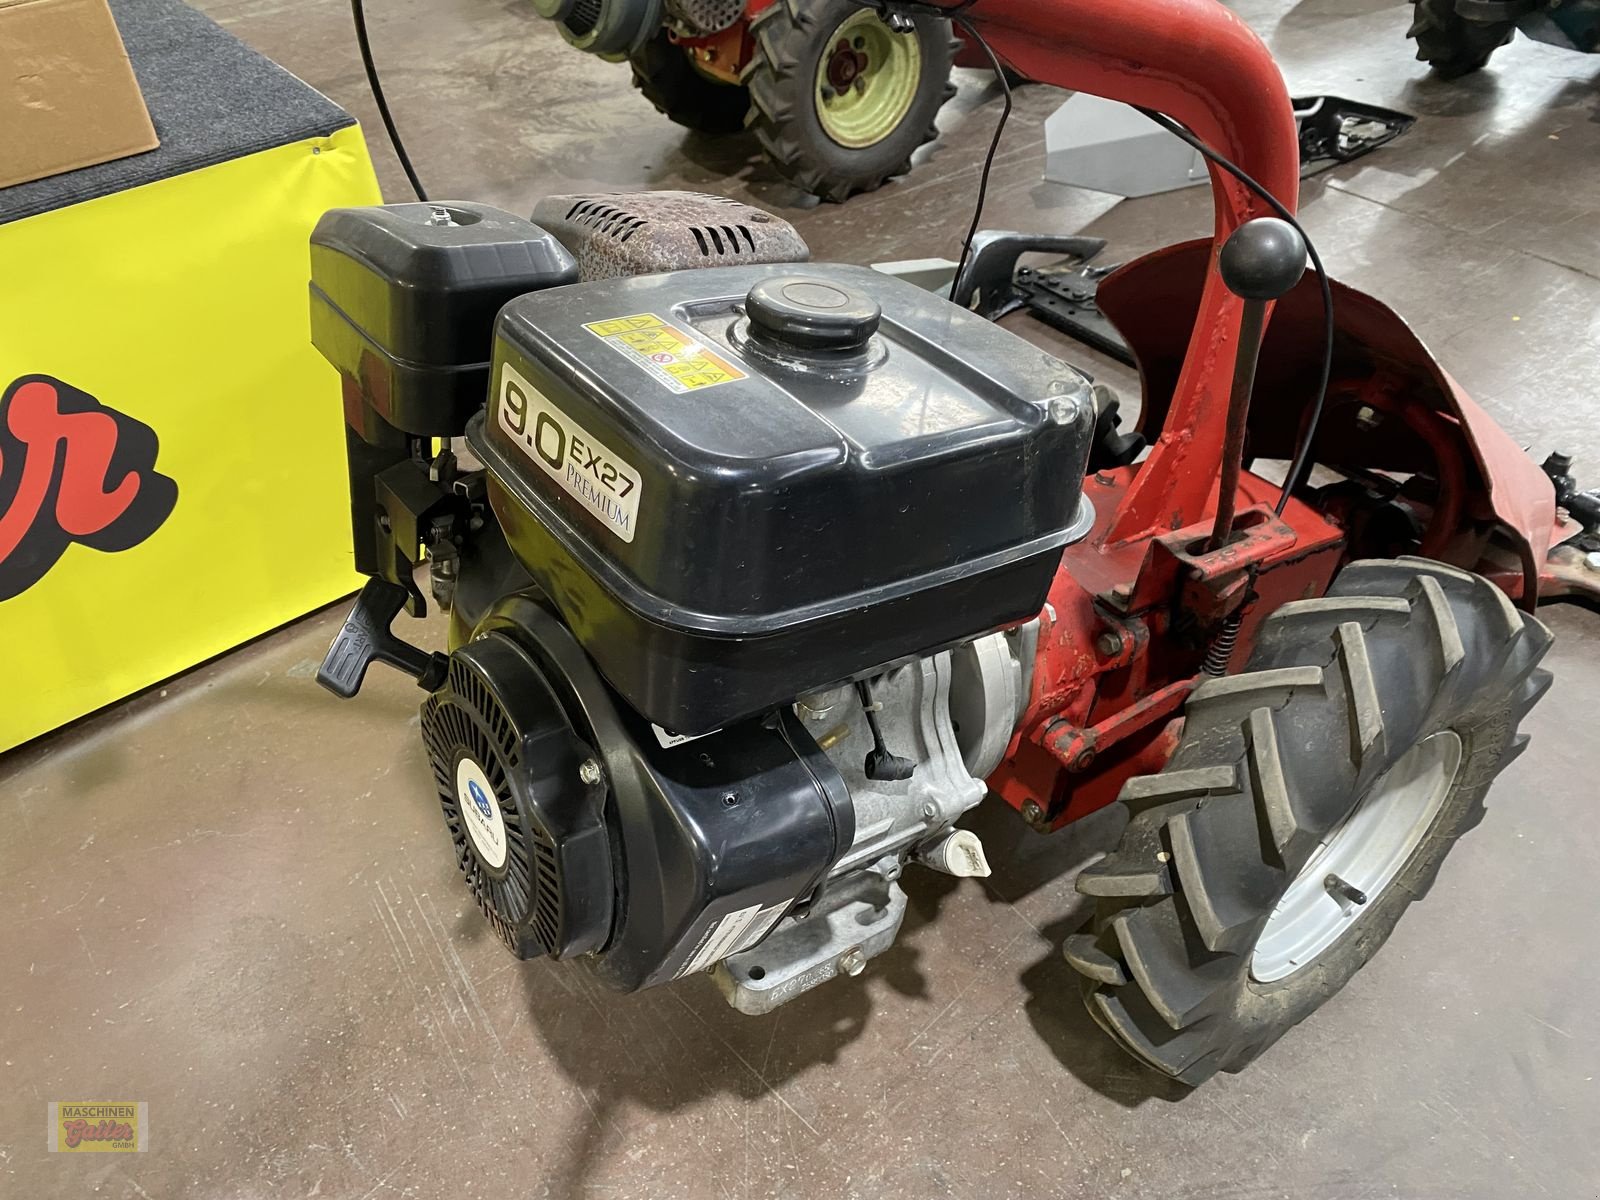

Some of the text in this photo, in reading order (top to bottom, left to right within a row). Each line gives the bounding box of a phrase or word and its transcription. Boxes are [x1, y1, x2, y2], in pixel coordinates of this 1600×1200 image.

[0, 382, 141, 564] r
[504, 380, 635, 499] 9.0 EX27
[565, 462, 630, 532] PREMIUM
